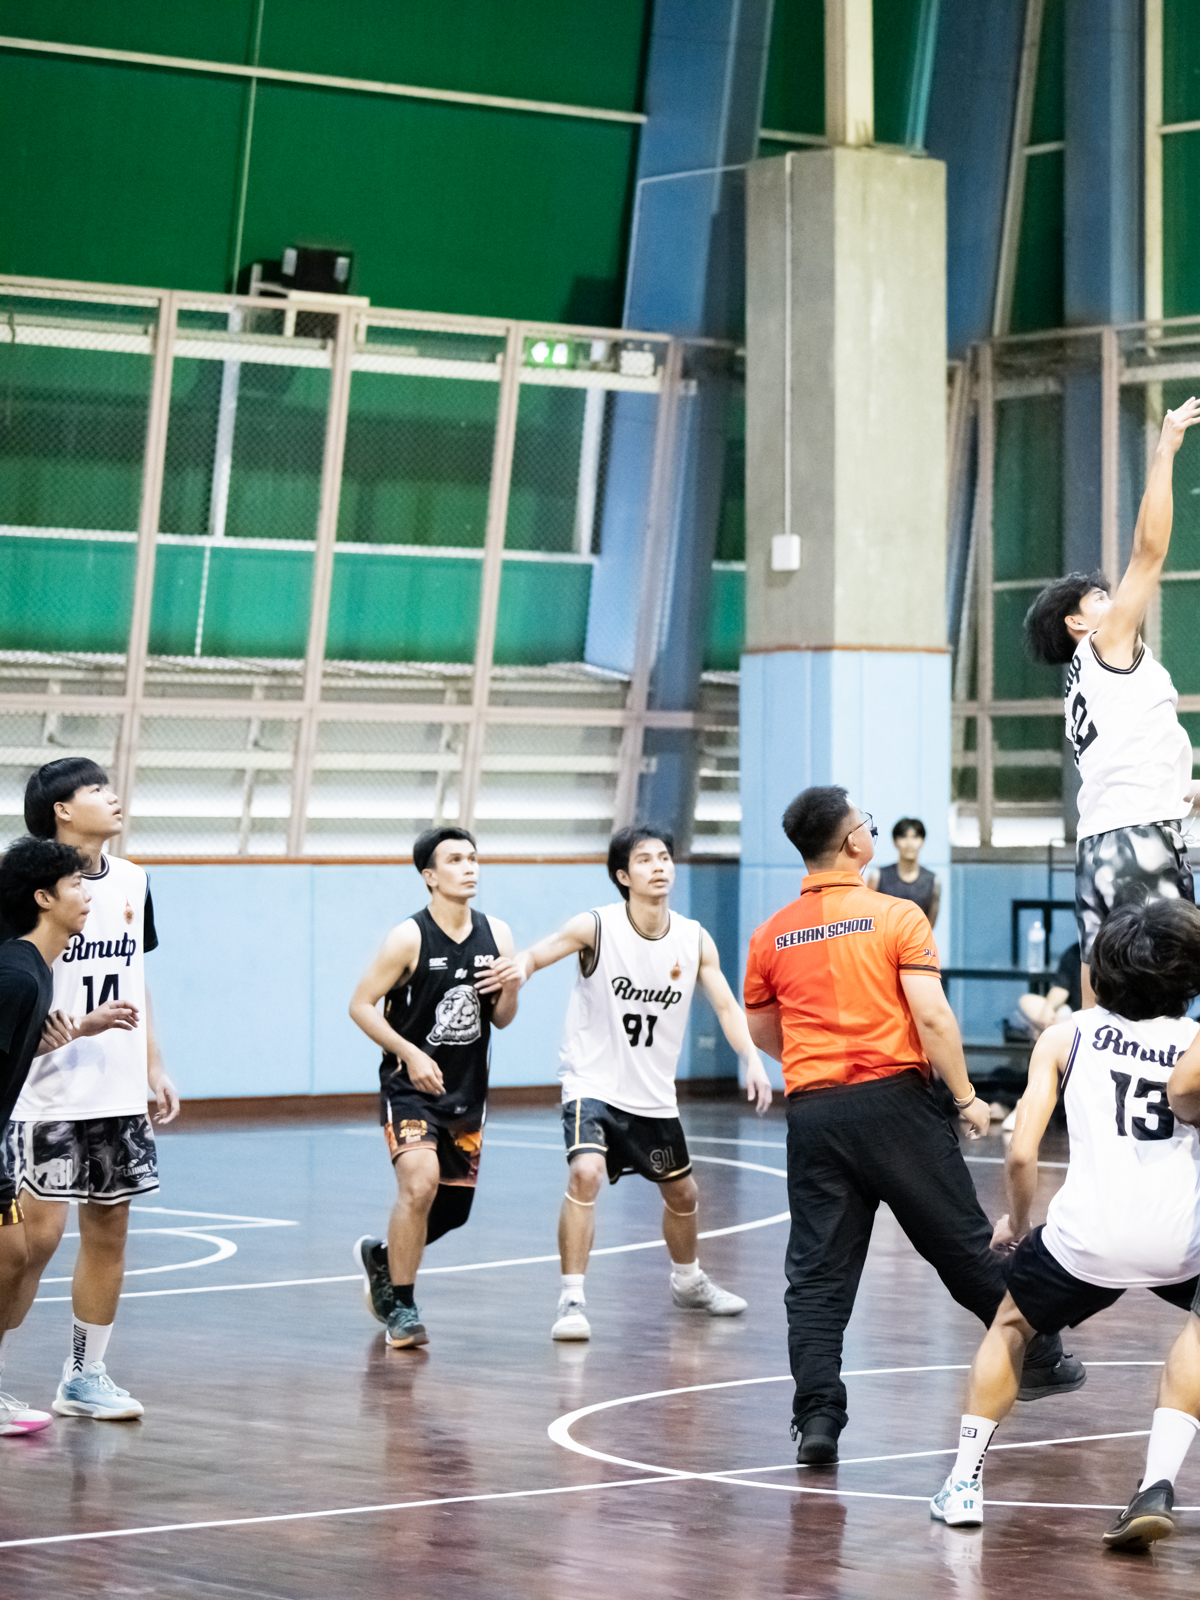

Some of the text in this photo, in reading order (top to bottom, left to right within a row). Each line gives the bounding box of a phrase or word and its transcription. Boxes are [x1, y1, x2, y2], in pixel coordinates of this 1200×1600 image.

[827, 917, 875, 939] SCHOOL
[62, 932, 137, 967] Rmutp
[611, 976, 682, 1010] Rmutp
[622, 1013, 658, 1047] 91
[1110, 1069, 1175, 1141] 13
[649, 1146, 676, 1173] 91
